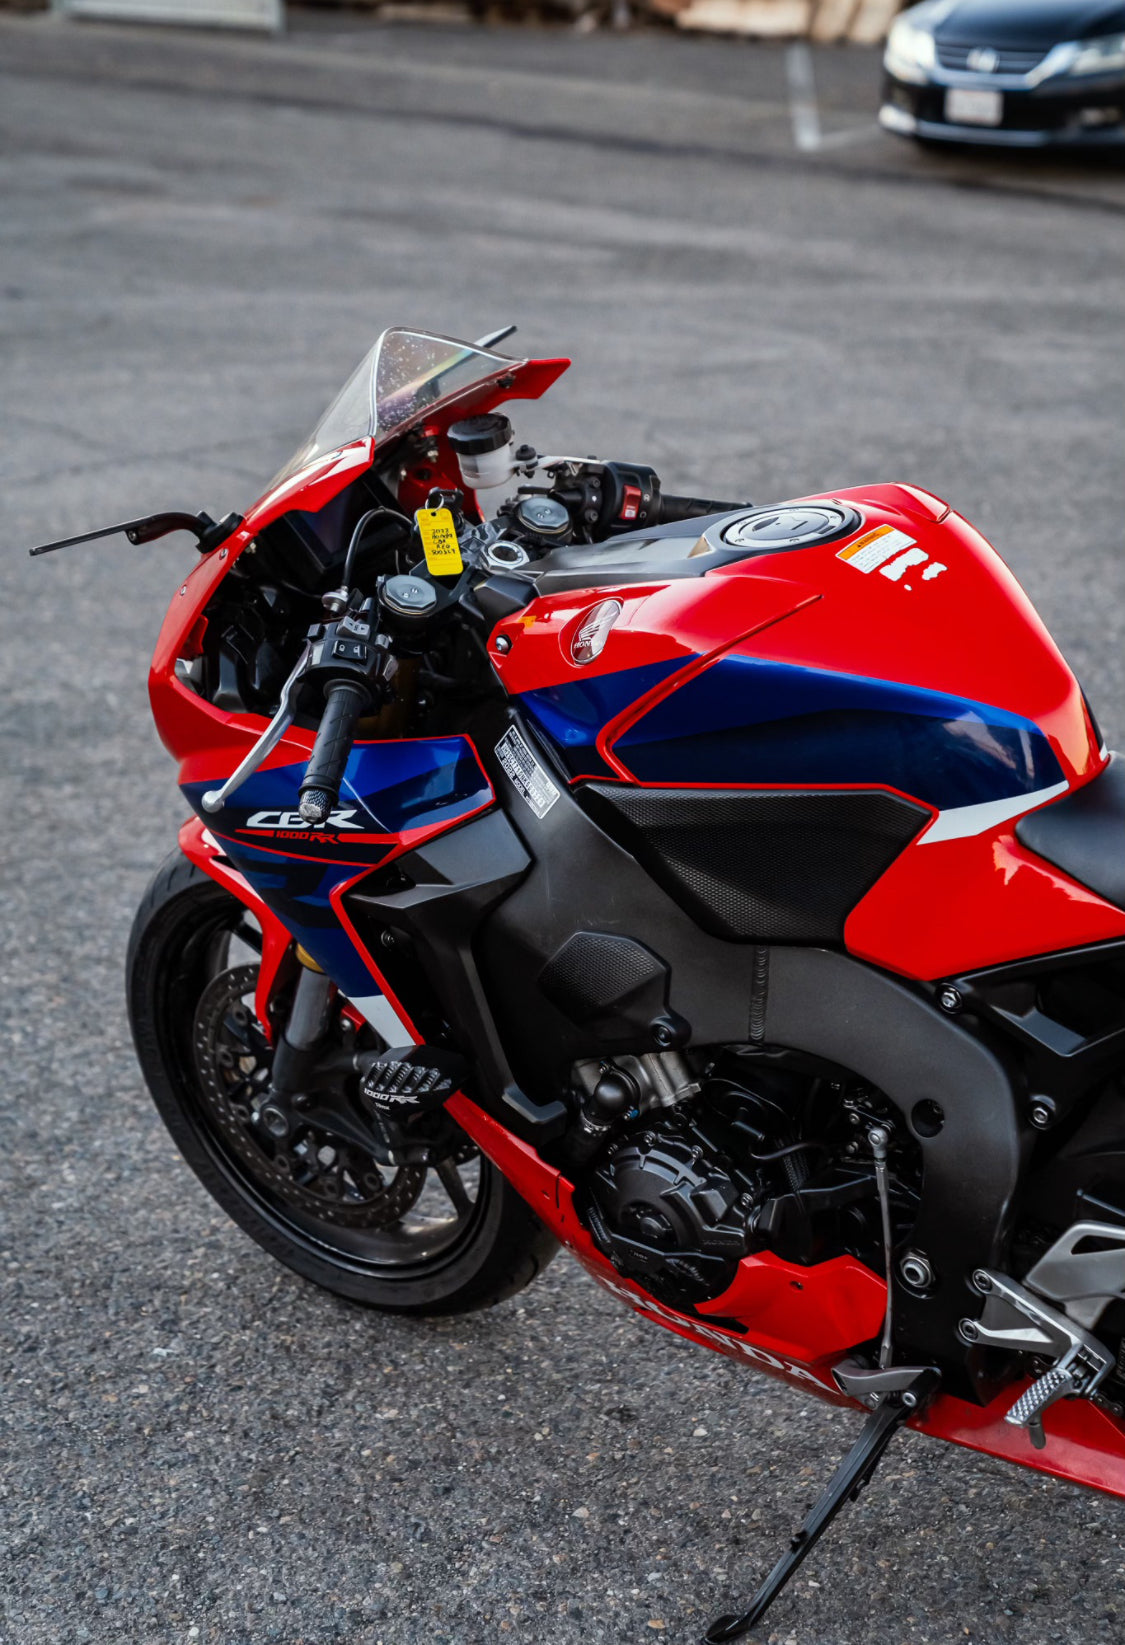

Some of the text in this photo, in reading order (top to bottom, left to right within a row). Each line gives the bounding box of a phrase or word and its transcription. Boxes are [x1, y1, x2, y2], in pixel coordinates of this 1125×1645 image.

[246, 810, 365, 829] CBR
[276, 830, 339, 844] 1000RR
[596, 1274, 839, 1394] HONDA
